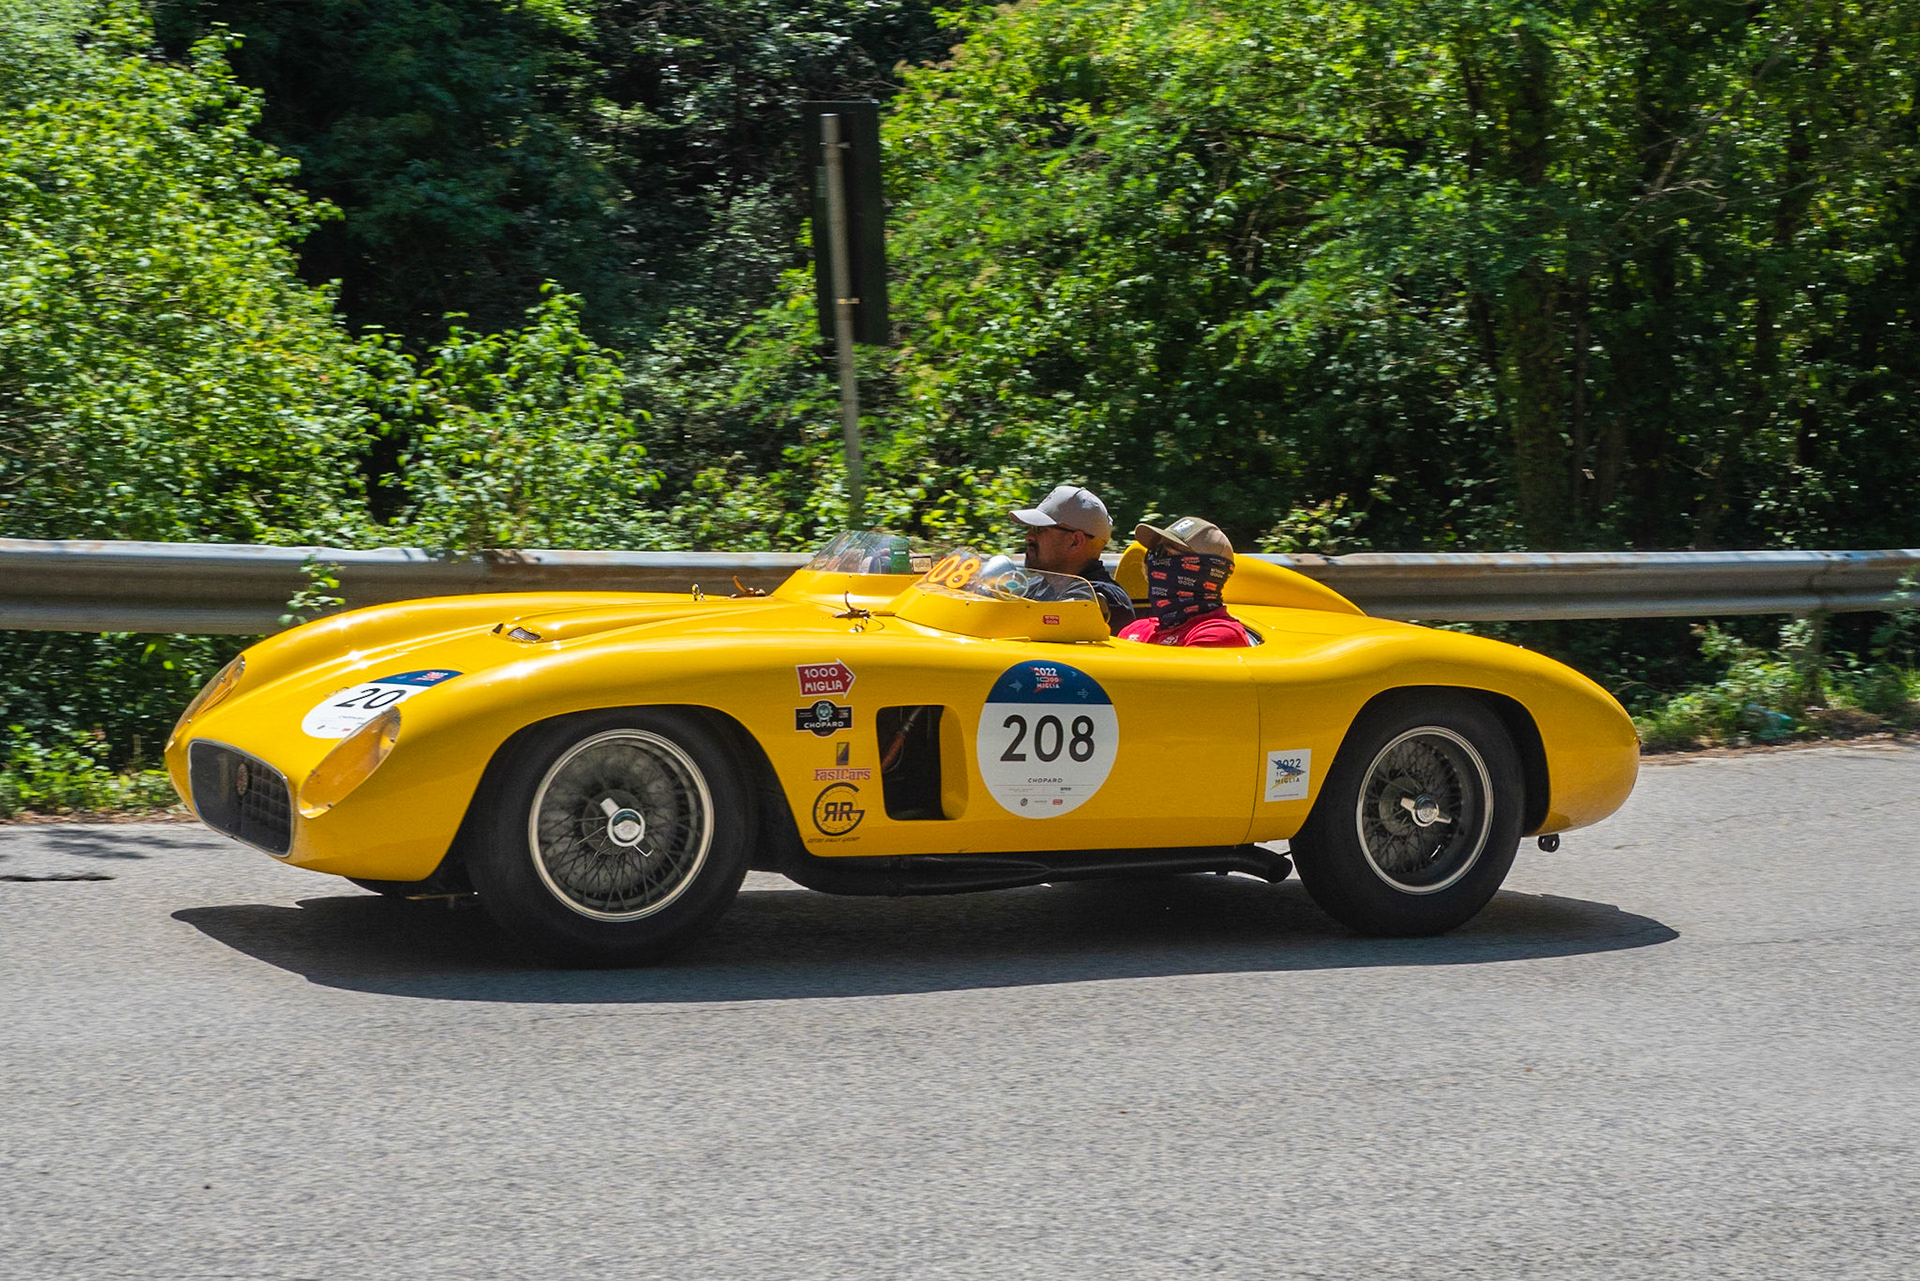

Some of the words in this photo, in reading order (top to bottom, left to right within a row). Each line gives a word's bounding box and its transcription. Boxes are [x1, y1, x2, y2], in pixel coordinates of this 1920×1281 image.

[803, 668, 838, 679] 1000
[1033, 667, 1058, 676] 2022
[804, 680, 843, 692] MIGLIA
[803, 721, 845, 729] CHOPARD
[999, 714, 1096, 763] 208
